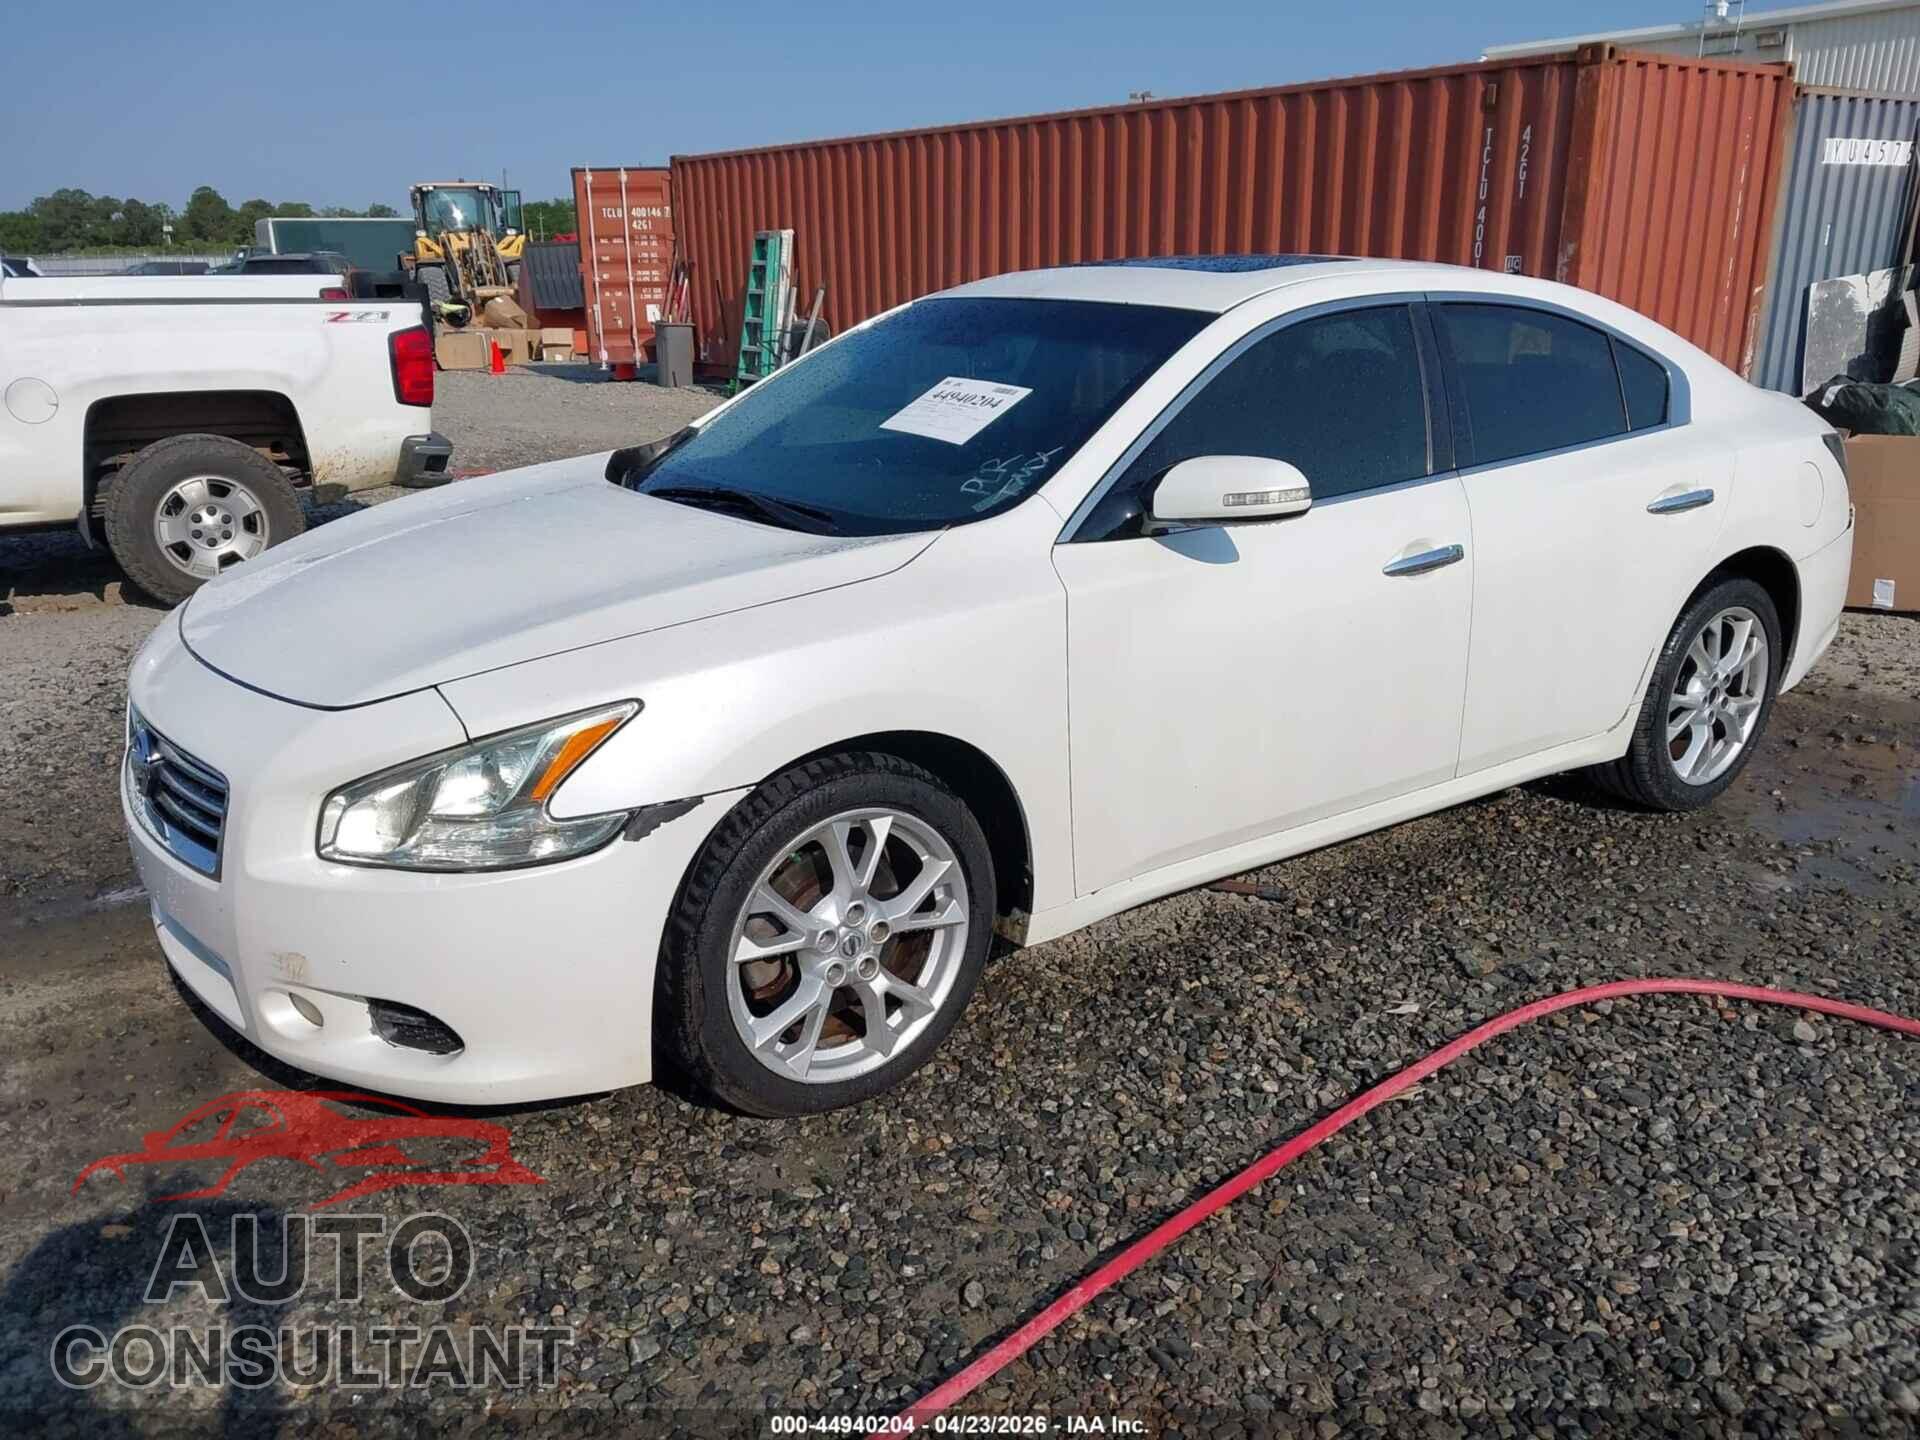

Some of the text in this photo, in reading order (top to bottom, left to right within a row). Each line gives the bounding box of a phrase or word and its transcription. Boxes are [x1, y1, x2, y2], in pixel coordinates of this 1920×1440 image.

[1479, 128, 1493, 200] TCLU
[1519, 125, 1531, 199] 42G1
[602, 207, 623, 218] TCLU
[631, 207, 661, 217] 400146
[632, 220, 652, 230] 42G1
[325, 311, 390, 323] Z71
[932, 390, 1004, 409] 44940204
